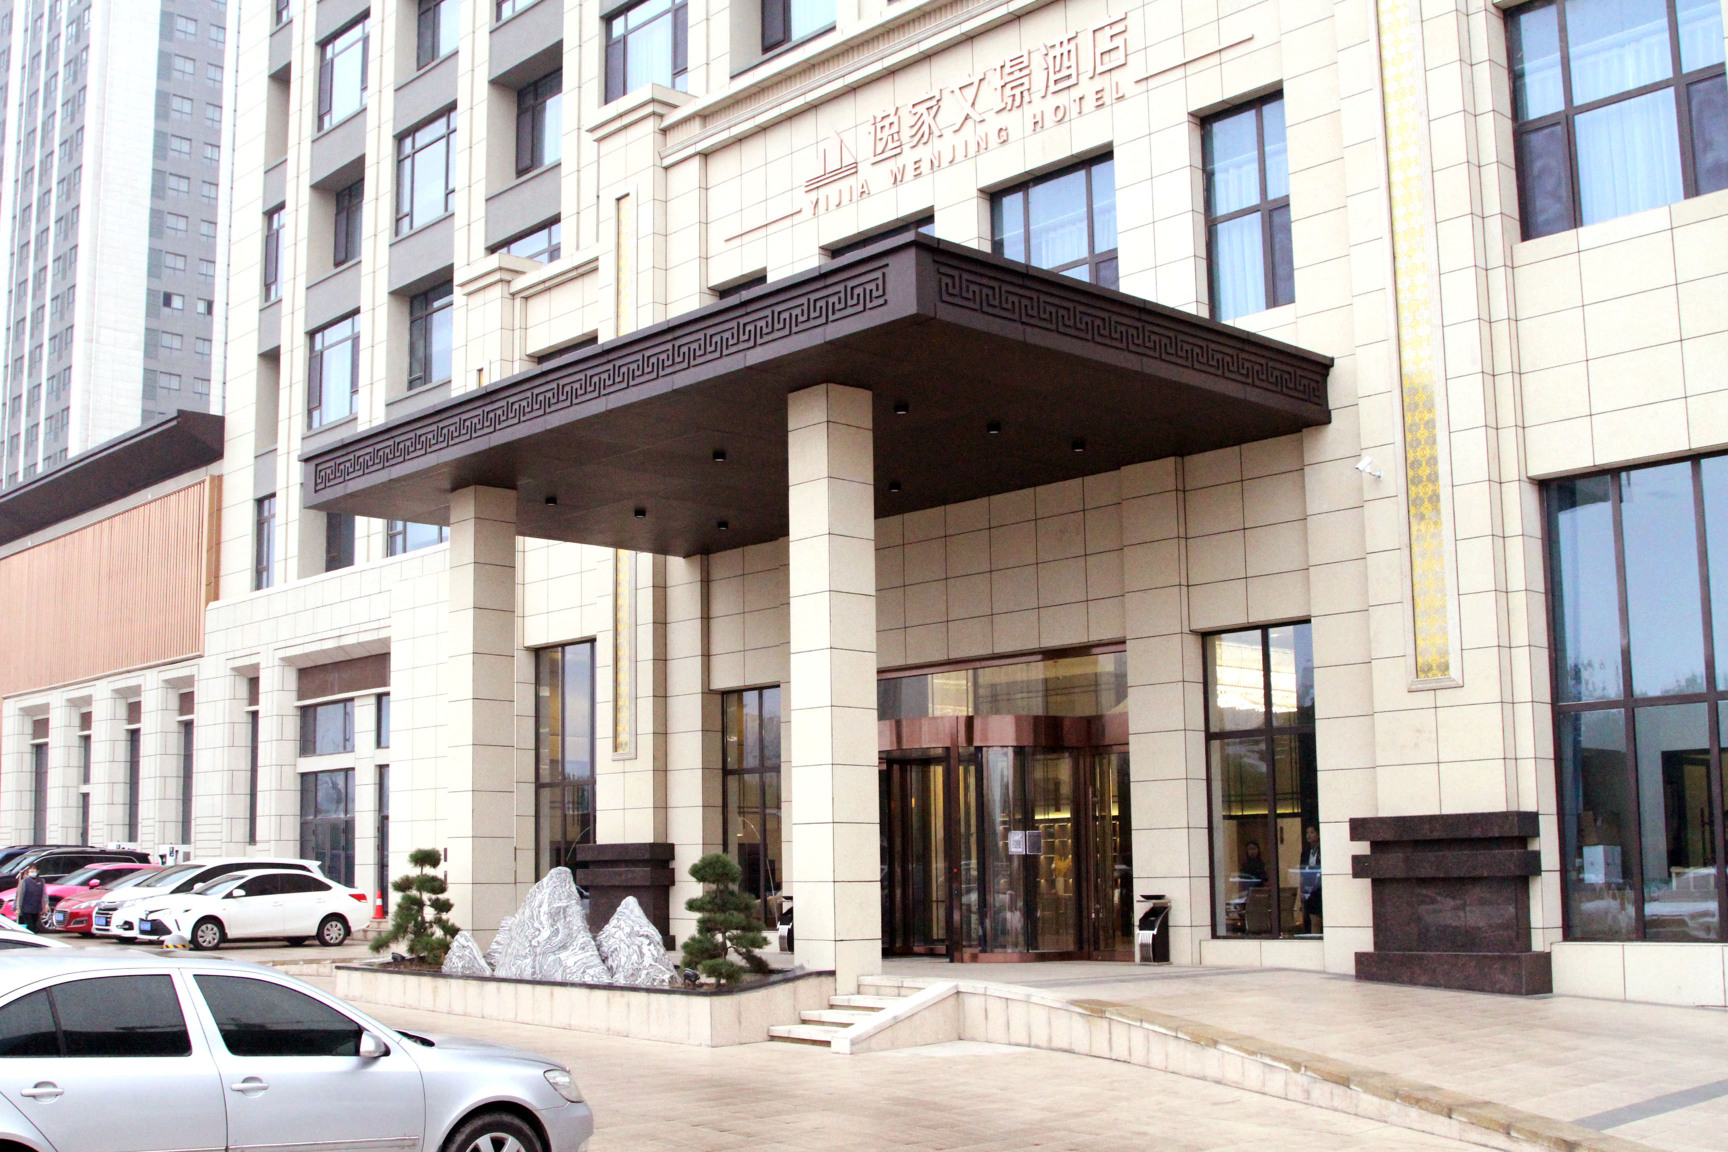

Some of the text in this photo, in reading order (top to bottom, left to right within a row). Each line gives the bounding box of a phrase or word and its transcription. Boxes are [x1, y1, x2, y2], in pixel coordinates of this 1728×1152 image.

[810, 80, 1126, 216] YIJIA WENJING HOTEL
[868, 11, 1127, 165] 逸家文璟酒店
